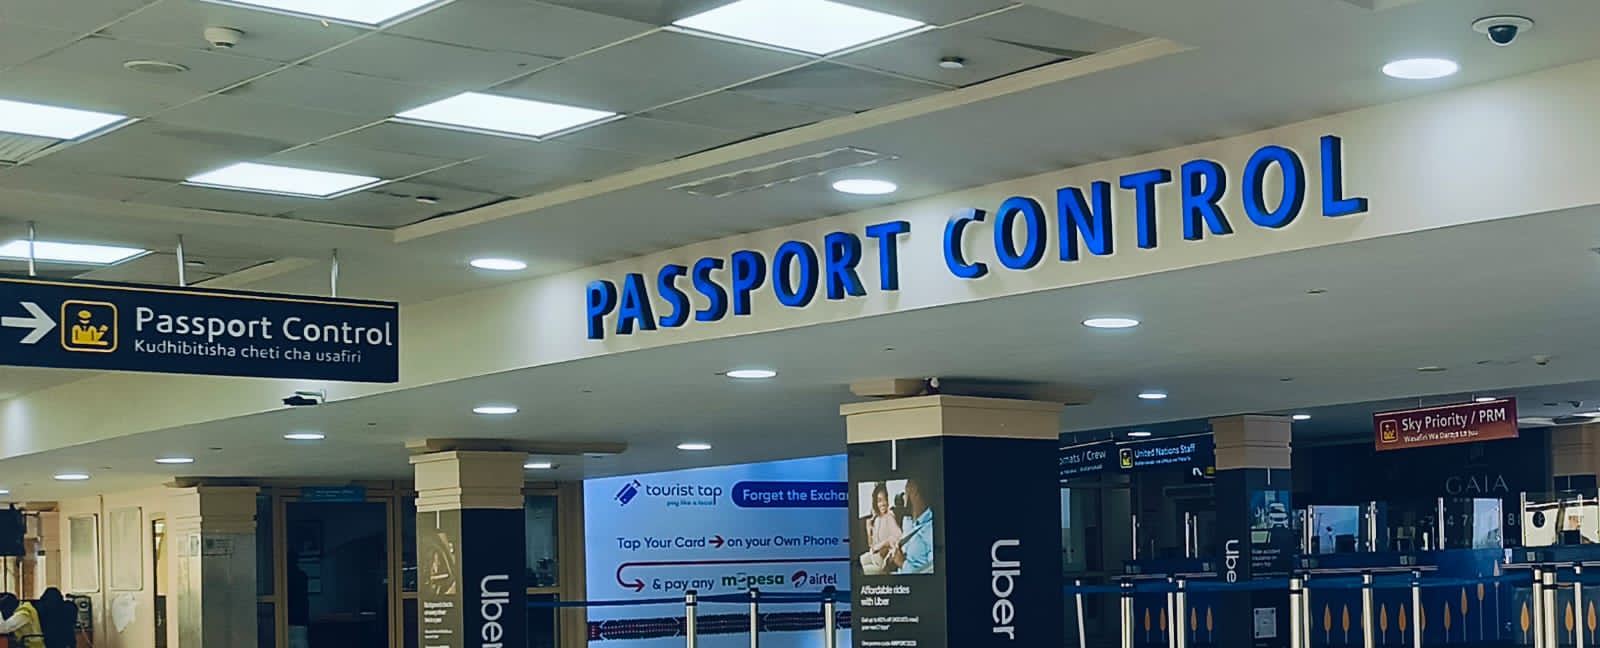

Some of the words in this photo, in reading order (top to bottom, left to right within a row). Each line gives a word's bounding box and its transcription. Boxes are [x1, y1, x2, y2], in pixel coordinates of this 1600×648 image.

[586, 220, 910, 340] PASSPORT
[943, 134, 1369, 280] CONTROL
[135, 306, 273, 343] Passport
[282, 316, 393, 347] Control
[134, 339, 237, 358] Kudhibitisha
[240, 344, 280, 360] cheti
[284, 346, 311, 362] cha
[316, 348, 362, 364] usafiri
[1401, 417, 1423, 433] Sky
[1425, 412, 1468, 429] Priority
[1479, 407, 1506, 423] PRM
[1086, 450, 1106, 461] Crew
[1156, 446, 1179, 457] Nations
[646, 483, 694, 497] tourist
[697, 484, 723, 505] tap
[1445, 473, 1510, 495] GAIA
[743, 489, 785, 504] Forget
[787, 489, 808, 501] the
[616, 537, 641, 551] Tap
[643, 537, 673, 549] Your
[674, 536, 706, 548] Card
[727, 537, 744, 547] on
[745, 537, 771, 550] your
[774, 536, 801, 547] Own
[803, 535, 839, 546] Phone
[1225, 539, 1240, 583] Ube
[652, 578, 661, 590] &
[664, 580, 688, 592] pay
[692, 578, 715, 591] any
[808, 573, 837, 585] airtel
[990, 539, 1021, 640] Uber
